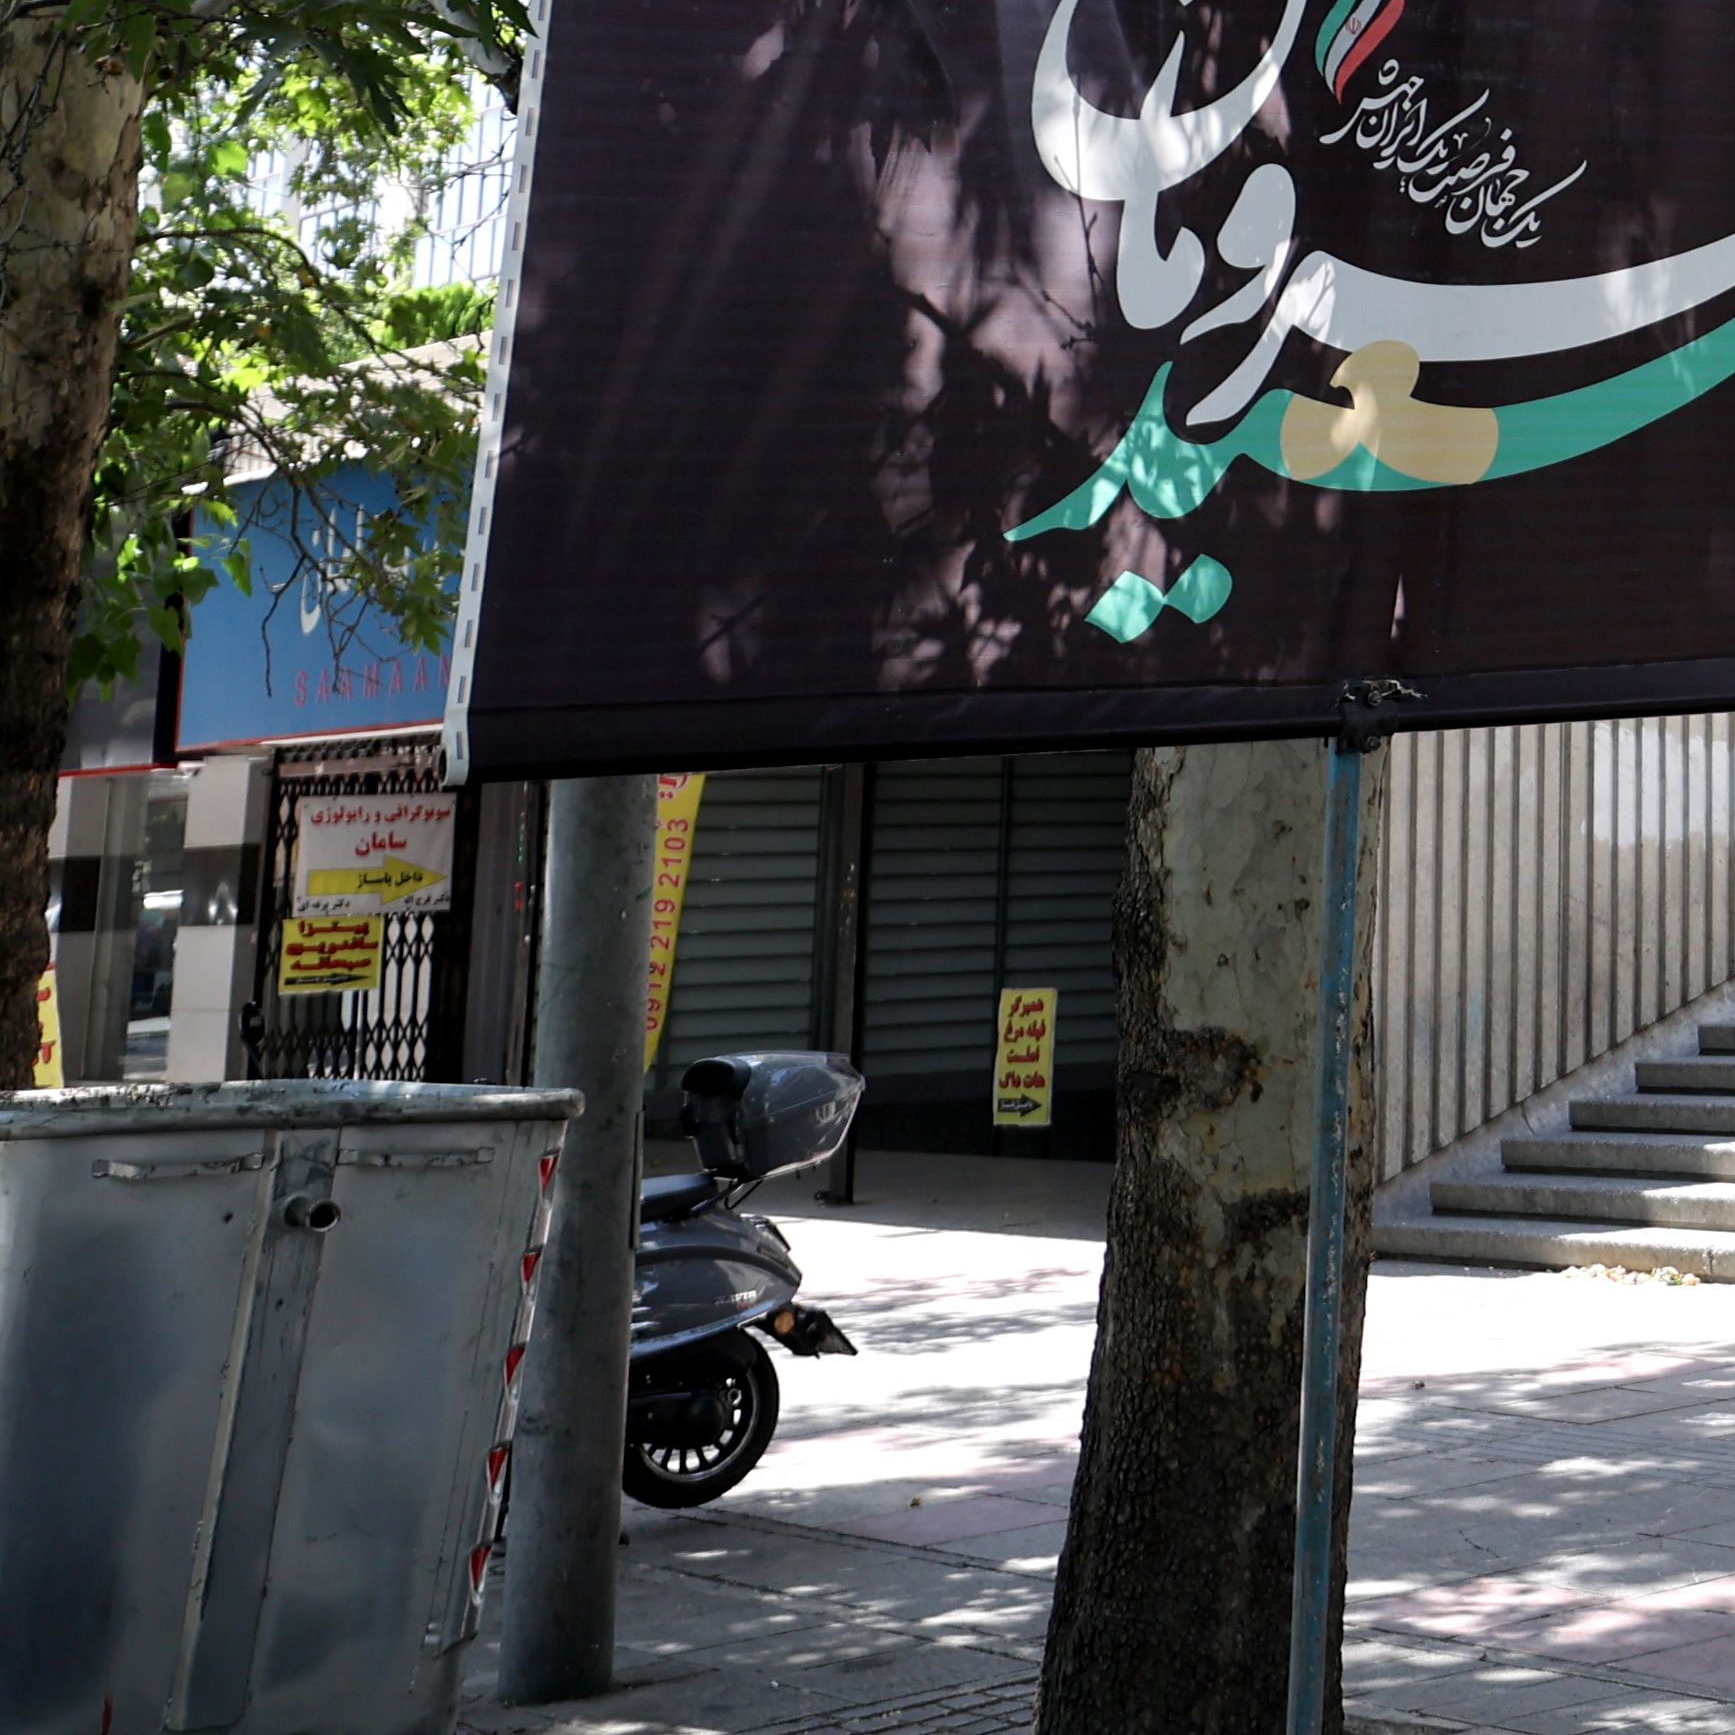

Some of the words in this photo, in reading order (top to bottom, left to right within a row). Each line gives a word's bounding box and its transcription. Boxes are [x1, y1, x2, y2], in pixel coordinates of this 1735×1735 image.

[1355, 97, 1428, 170] ایران
[1445, 168, 1530, 235] جهان
[355, 830, 407, 856] سامان
[658, 817, 690, 891] 2103
[394, 868, 424, 887] داخل
[298, 919, 370, 939] پیتزا
[651, 898, 676, 953] 219
[286, 936, 379, 956] ساندویچ
[290, 954, 372, 971] صبحانه
